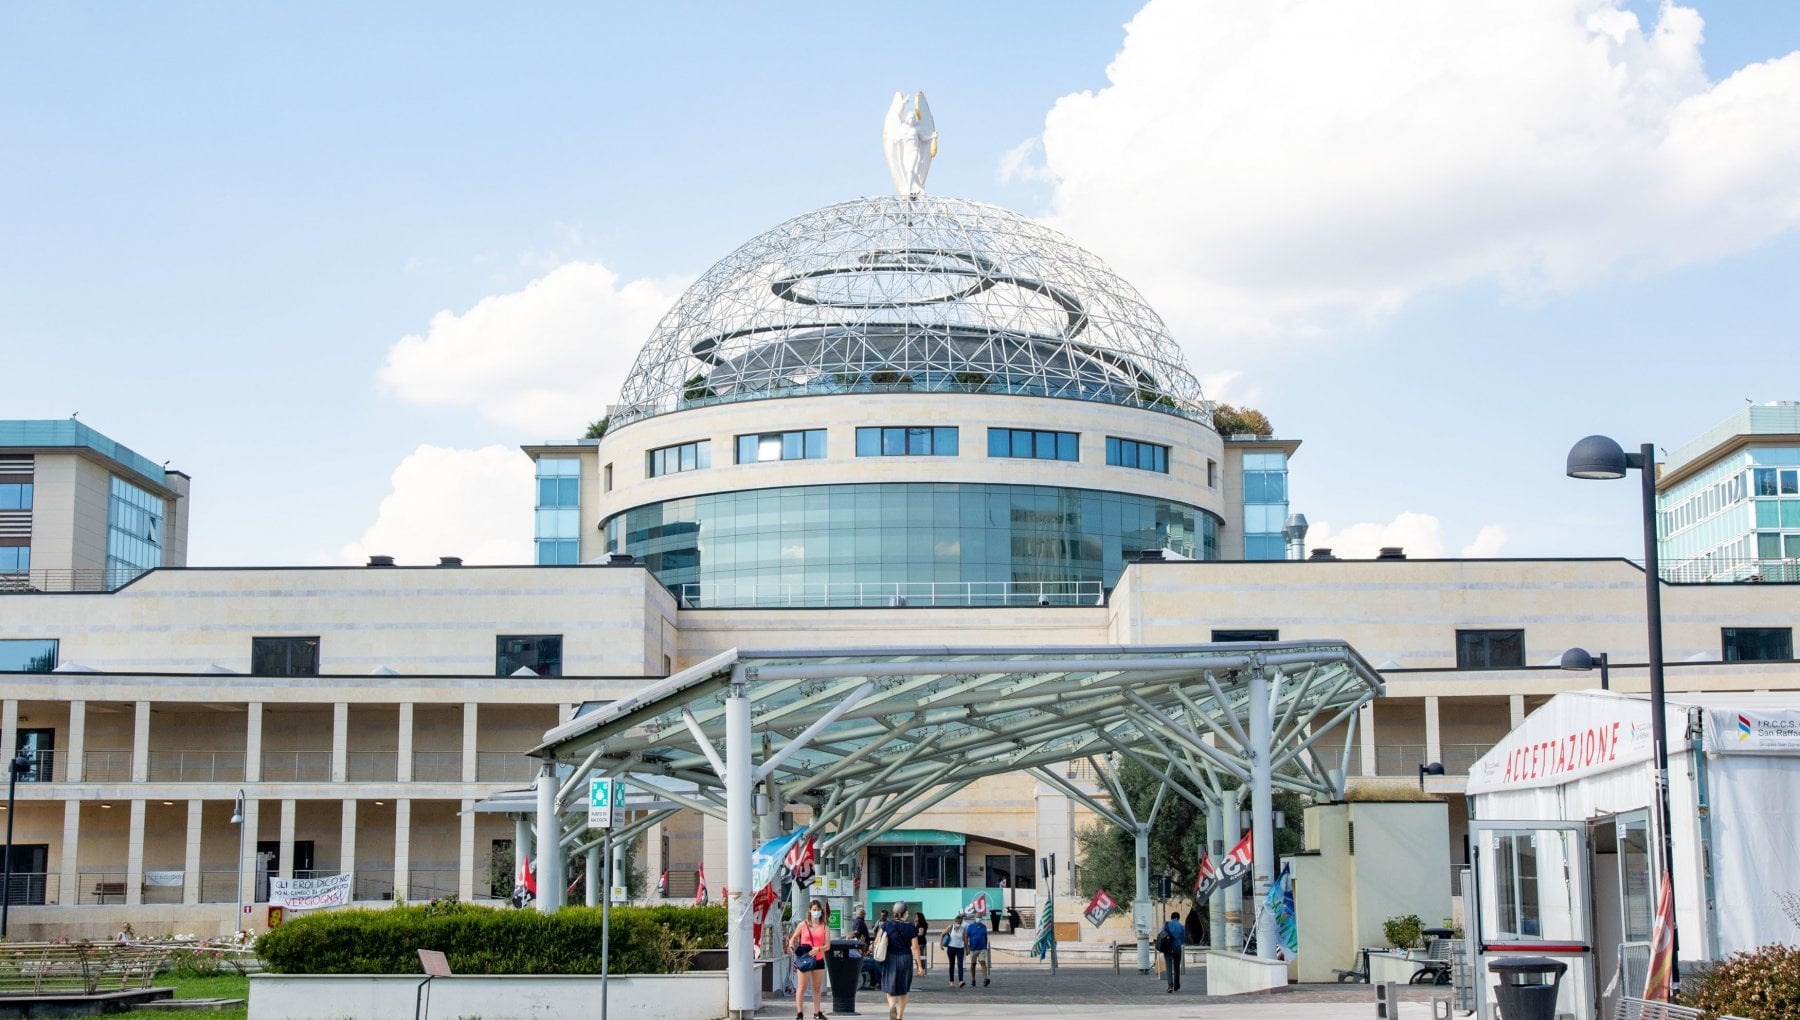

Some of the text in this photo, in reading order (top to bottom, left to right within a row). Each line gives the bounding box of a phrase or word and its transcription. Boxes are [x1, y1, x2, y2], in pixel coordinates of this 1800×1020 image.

[1758, 729, 1774, 737] San
[1503, 721, 1620, 783] ACCETTAZIONE
[275, 880, 288, 889] GLI
[293, 880, 314, 889] EROI
